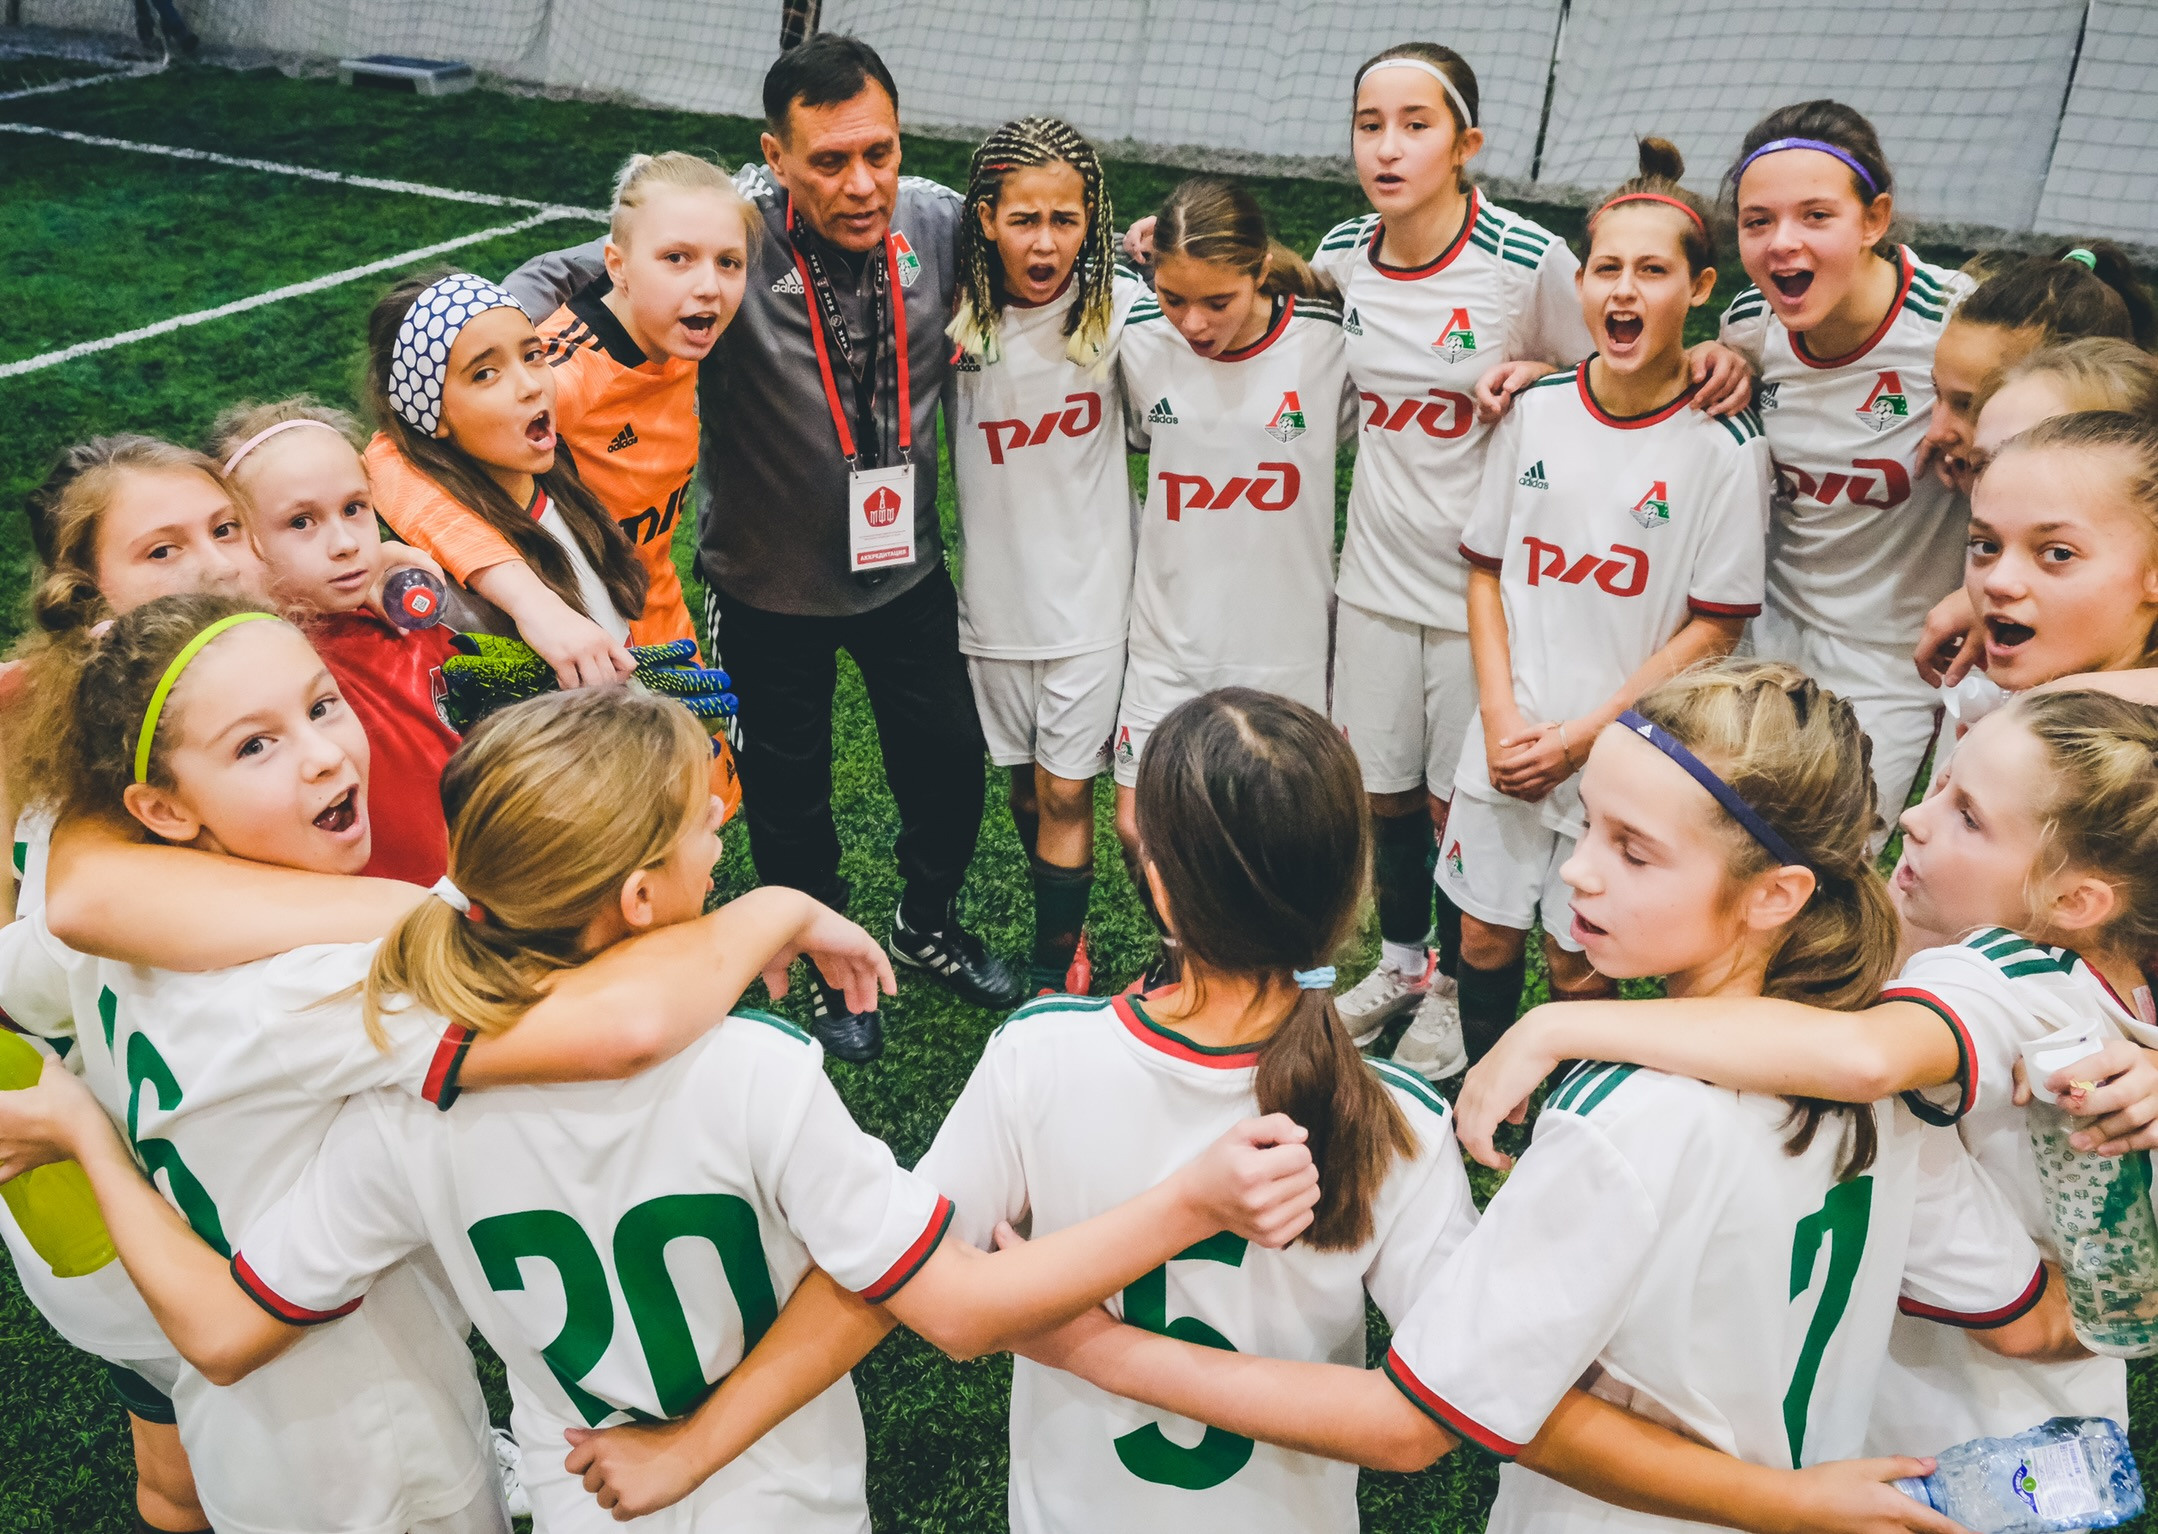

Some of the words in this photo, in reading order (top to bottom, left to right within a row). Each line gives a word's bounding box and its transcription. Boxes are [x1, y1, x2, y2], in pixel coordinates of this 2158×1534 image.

[771, 283, 805, 295] adida
[607, 436, 639, 453] adidas
[1518, 476, 1550, 491] adidas
[466, 1192, 779, 1428] 20
[1112, 1229, 1256, 1491] 5
